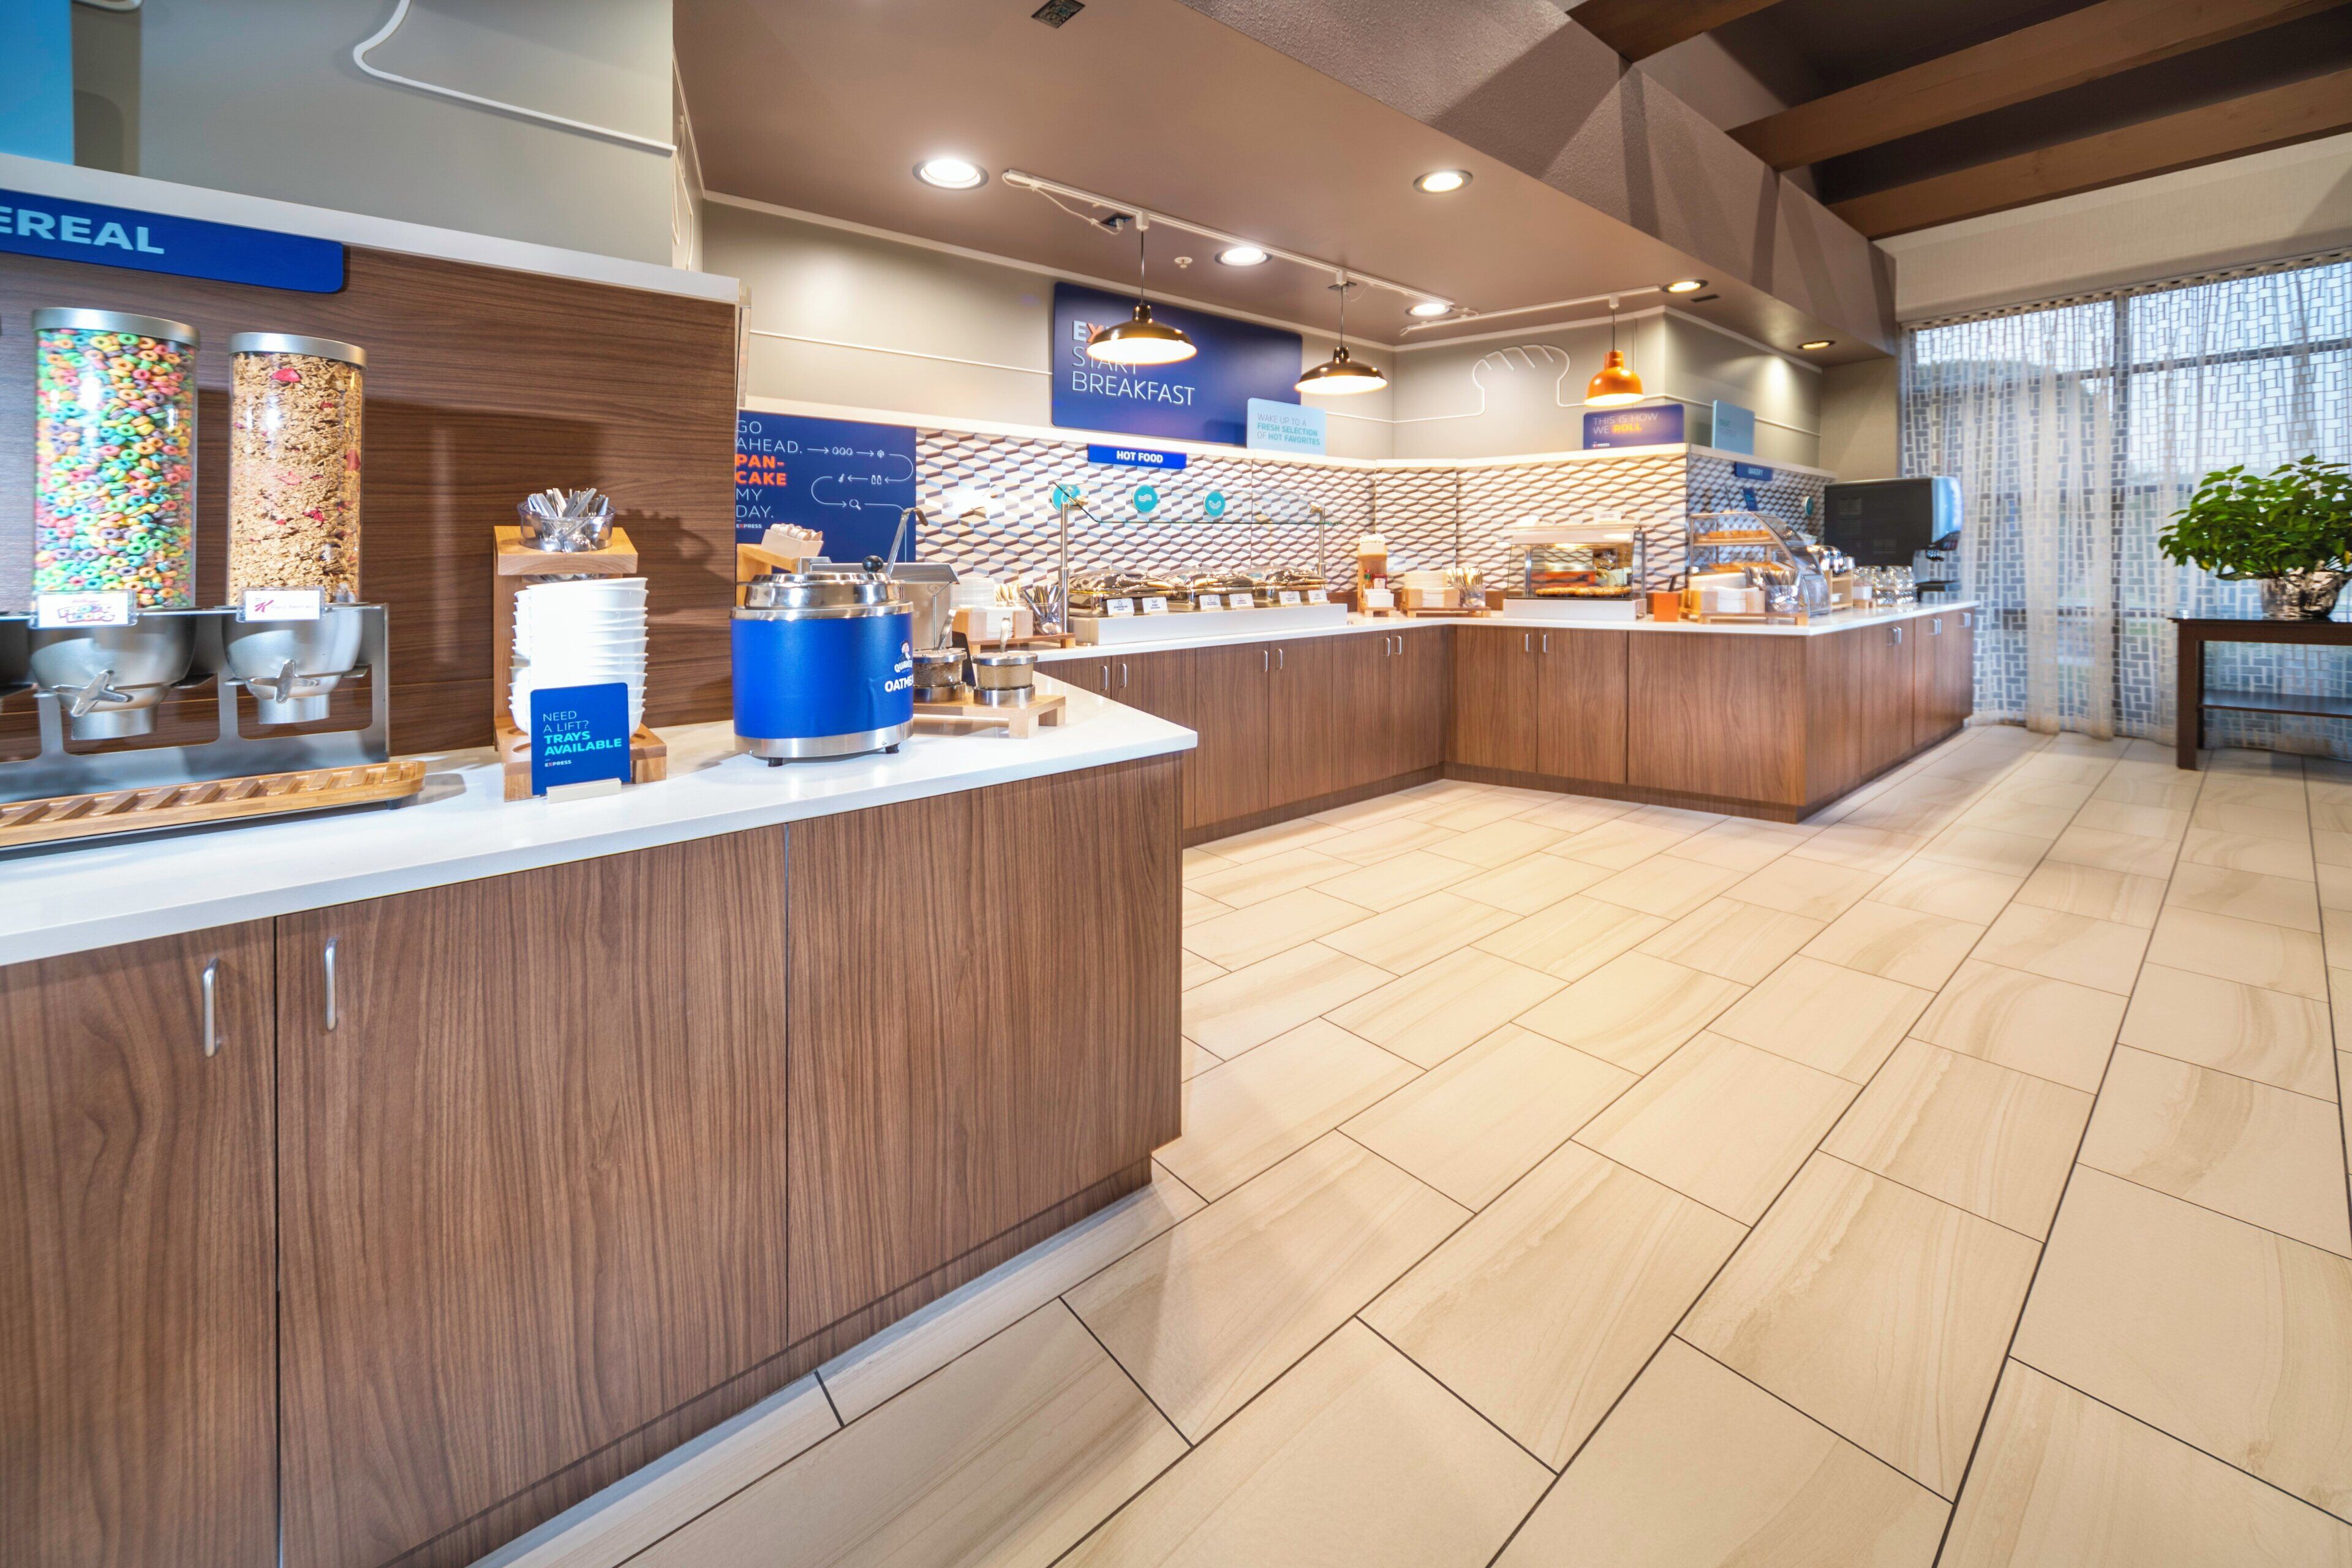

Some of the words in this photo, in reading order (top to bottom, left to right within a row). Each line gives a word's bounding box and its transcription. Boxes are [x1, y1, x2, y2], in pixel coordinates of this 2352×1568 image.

[1072, 371, 1195, 405] BREAKFAST
[1257, 413, 1278, 423] WAKE
[1291, 417, 1300, 426] TO
[1593, 416, 1616, 425] THIS
[1631, 412, 1659, 421] HOW
[736, 420, 761, 434] GO
[1257, 422, 1280, 432] FRESH
[1282, 425, 1318, 437] SELECTION
[1613, 423, 1643, 432] ROLL
[737, 437, 802, 453] AHEAD.
[1284, 434, 1321, 445] FAVORITES
[735, 454, 785, 469] PAN-
[1117, 450, 1136, 461] HOT
[1138, 452, 1163, 463] FOOD
[735, 470, 787, 486] CAKE
[736, 488, 763, 501] MY
[736, 505, 774, 518] DAY.
[67, 612, 115, 623] LOOPS
[543, 710, 577, 722] NEED
[543, 724, 552, 733] A
[557, 720, 589, 732] LIFT?
[544, 731, 590, 744] TRAYS
[544, 738, 622, 756] AVAILABLE
